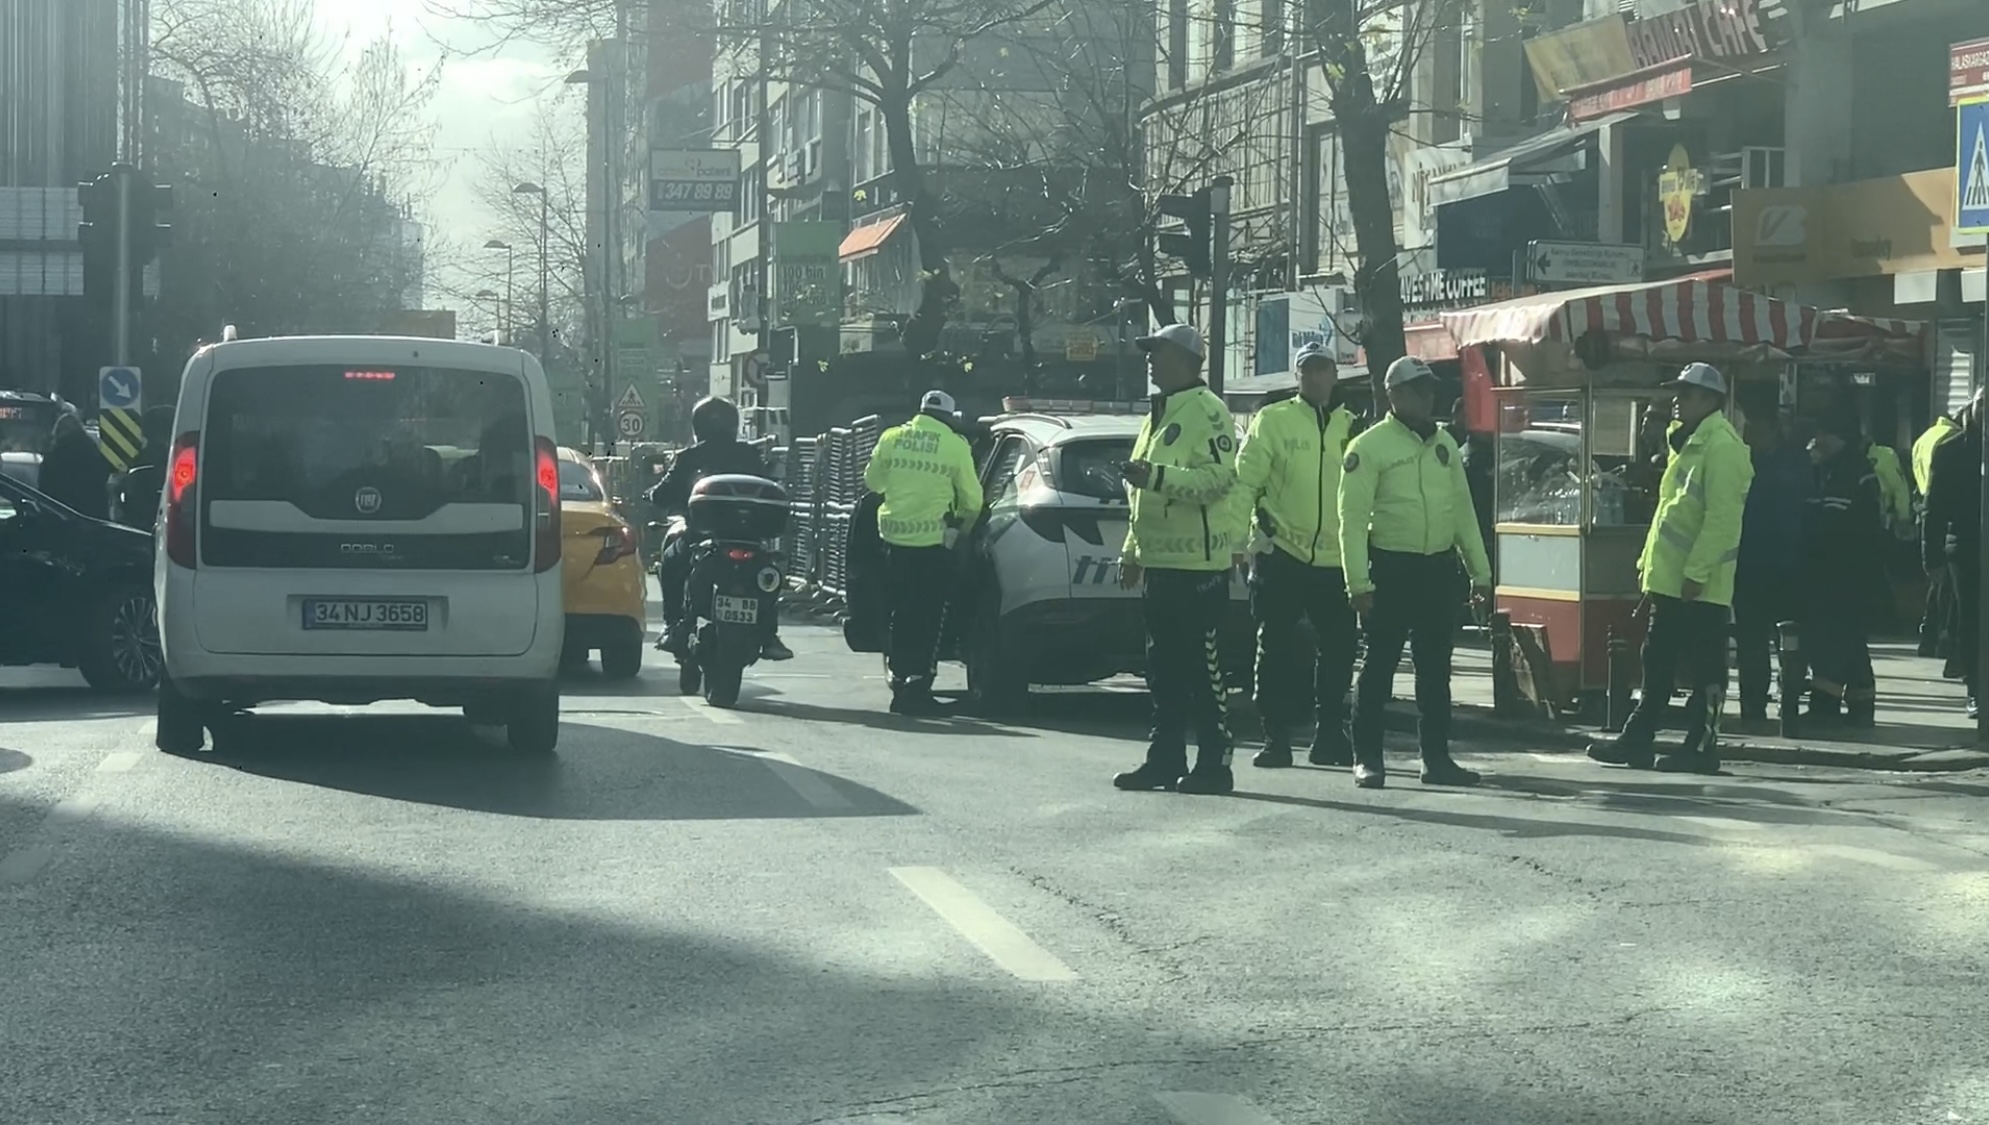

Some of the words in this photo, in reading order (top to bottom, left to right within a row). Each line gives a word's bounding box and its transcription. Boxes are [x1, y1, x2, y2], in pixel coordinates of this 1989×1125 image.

[666, 183, 693, 199] 347
[694, 183, 712, 199] 89
[714, 183, 733, 199] 89
[622, 418, 640, 432] 30
[717, 597, 731, 608] 34
[316, 604, 341, 621] 34
[344, 604, 371, 622] NJ
[376, 604, 425, 622] 3658
